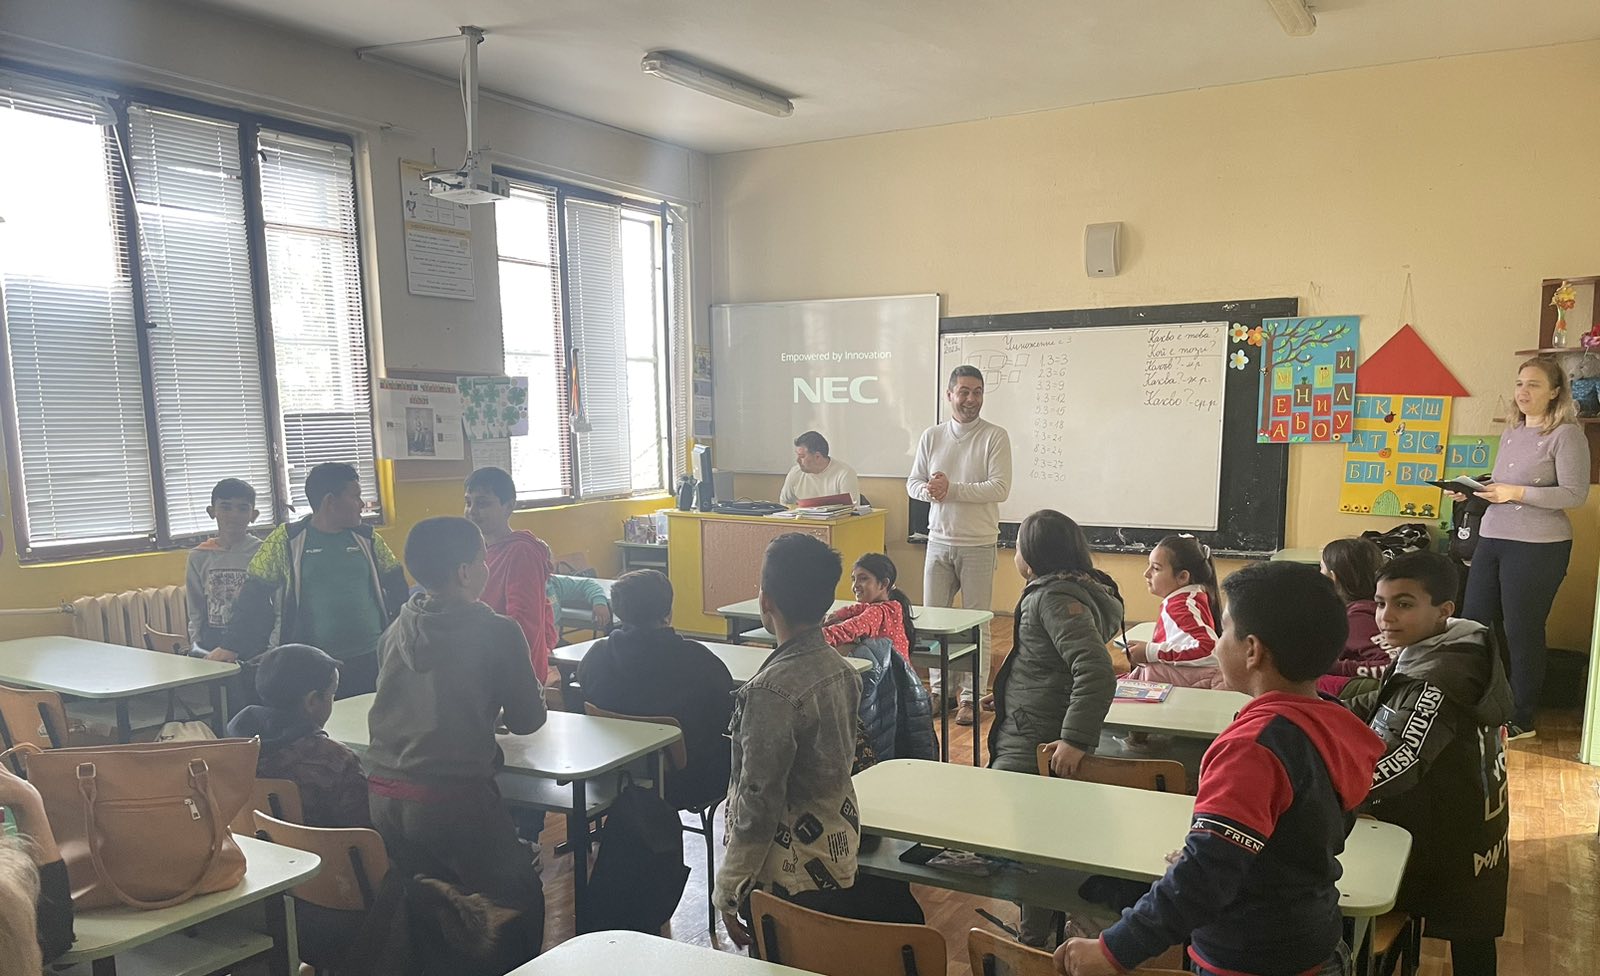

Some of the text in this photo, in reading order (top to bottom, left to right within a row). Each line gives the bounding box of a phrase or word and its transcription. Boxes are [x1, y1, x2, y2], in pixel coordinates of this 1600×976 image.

[781, 351, 892, 363] Empowered by Innovation
[793, 376, 879, 404] NEC
[1276, 398, 1287, 413] Е
[1272, 423, 1328, 438] А О
[1224, 828, 1264, 851] FRIEN
